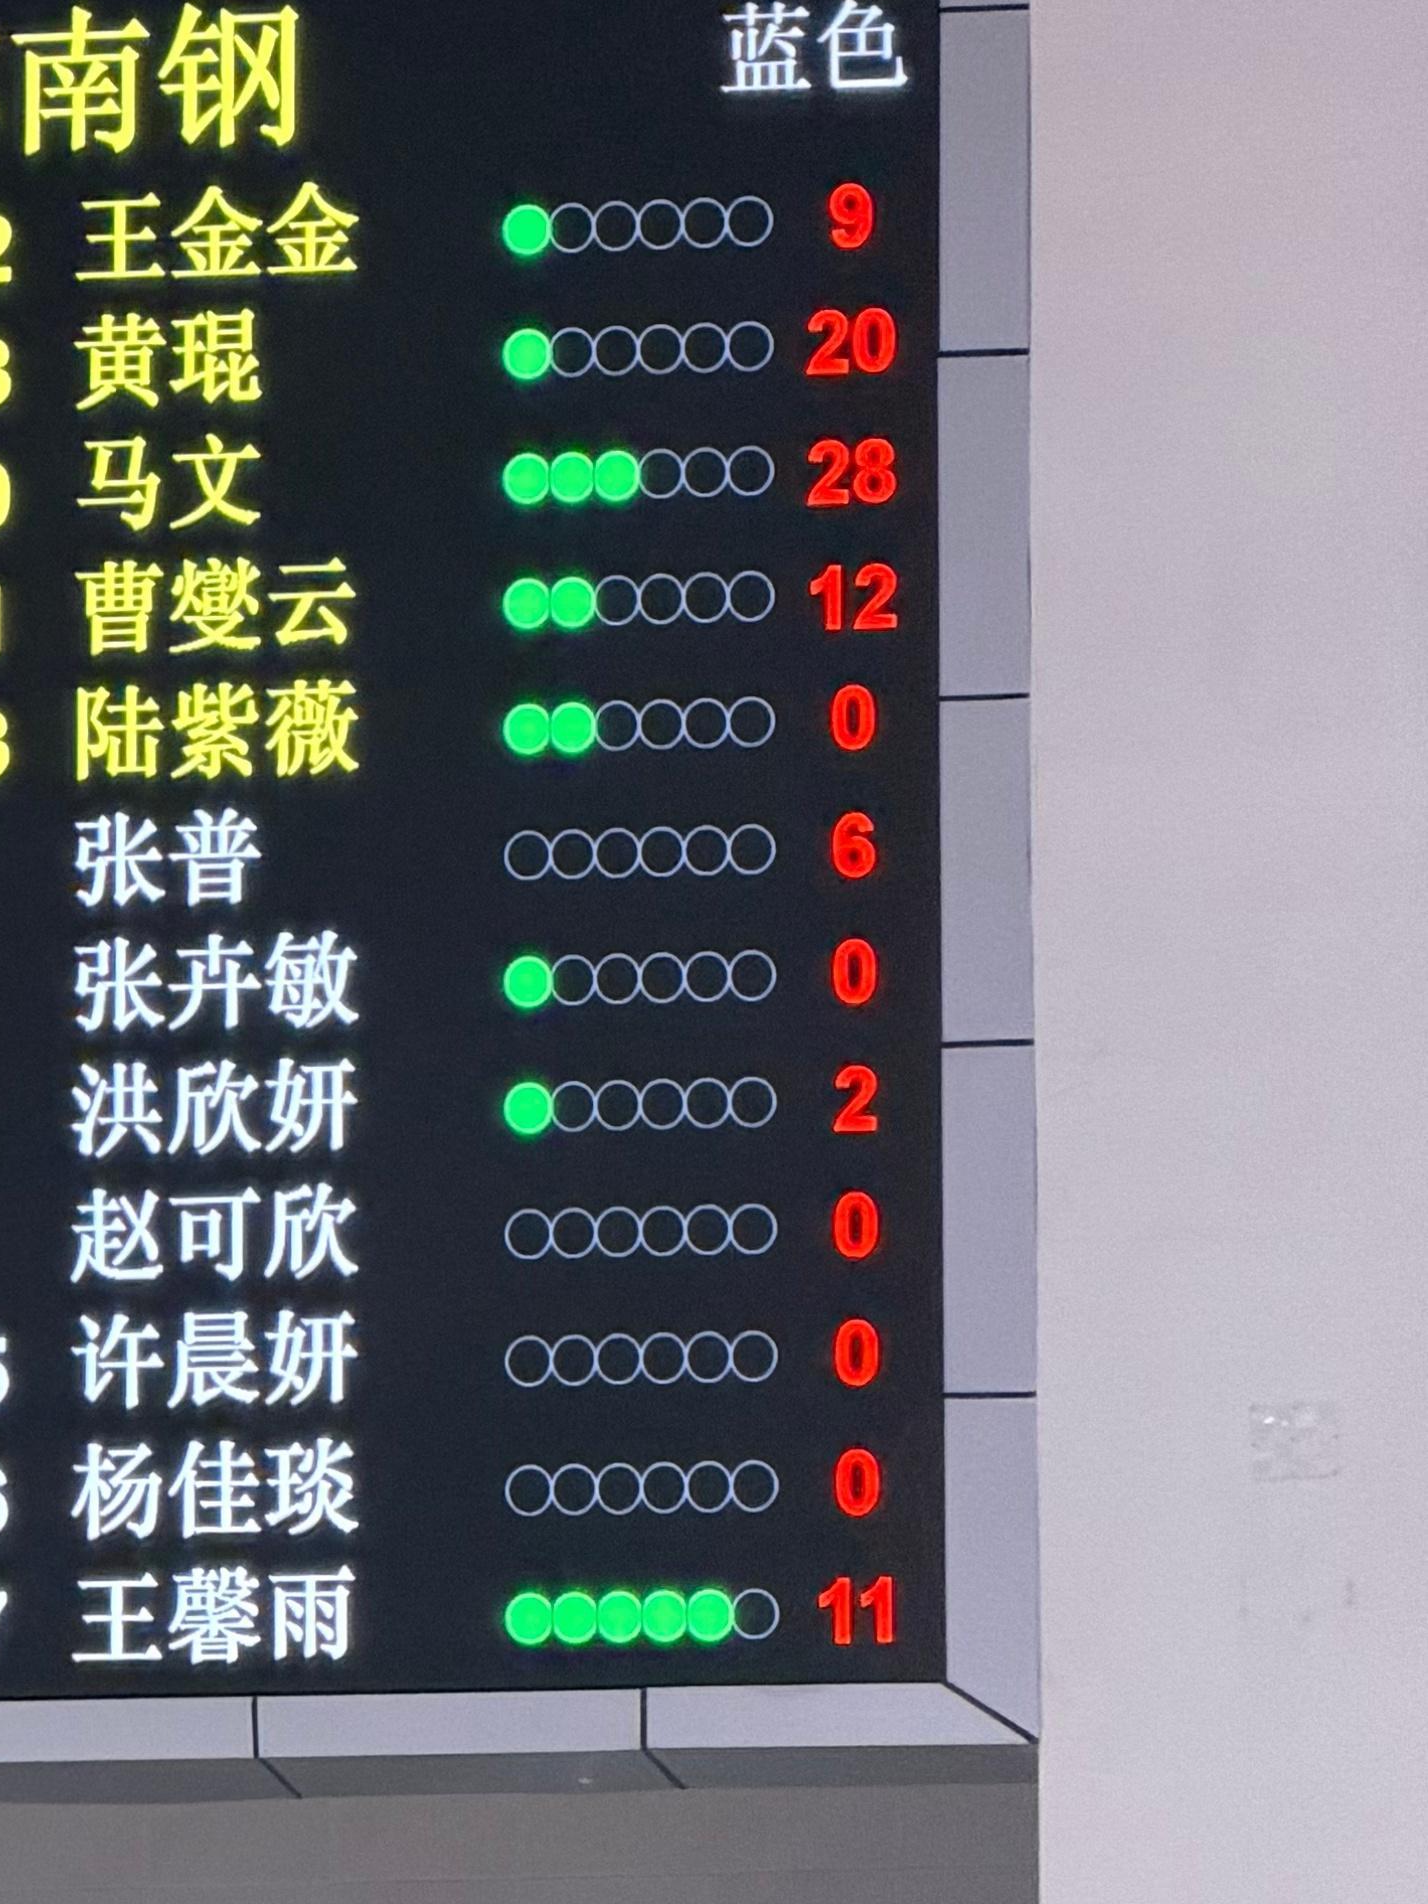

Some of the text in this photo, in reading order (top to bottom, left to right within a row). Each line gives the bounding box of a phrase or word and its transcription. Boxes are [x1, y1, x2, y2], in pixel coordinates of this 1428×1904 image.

[75, 182, 359, 281] 王金金
[827, 183, 874, 250] 9
[74, 308, 262, 410] 黄琨
[805, 308, 896, 375] 20
[77, 433, 261, 531] 马文
[807, 438, 897, 507] 28
[75, 556, 356, 656] 曹燮云
[810, 563, 897, 631] 12
[76, 678, 359, 782] 陆紫薇
[830, 684, 876, 751] 0
[74, 807, 262, 908] 张普
[830, 812, 877, 880] 6
[74, 930, 359, 1033] 张卉敏
[830, 938, 878, 1006] 0
[70, 1057, 358, 1159] 洪欣妍
[832, 1065, 878, 1133] 2
[70, 1181, 359, 1283] 赵可欣
[831, 1191, 879, 1260] 0
[71, 1307, 358, 1410] 许晨妍
[832, 1319, 880, 1387] 0
[70, 1435, 359, 1541] 杨佳琰
[833, 1448, 881, 1517] 0
[72, 1564, 356, 1665] 王馨雨
[818, 1576, 894, 1645] 11
